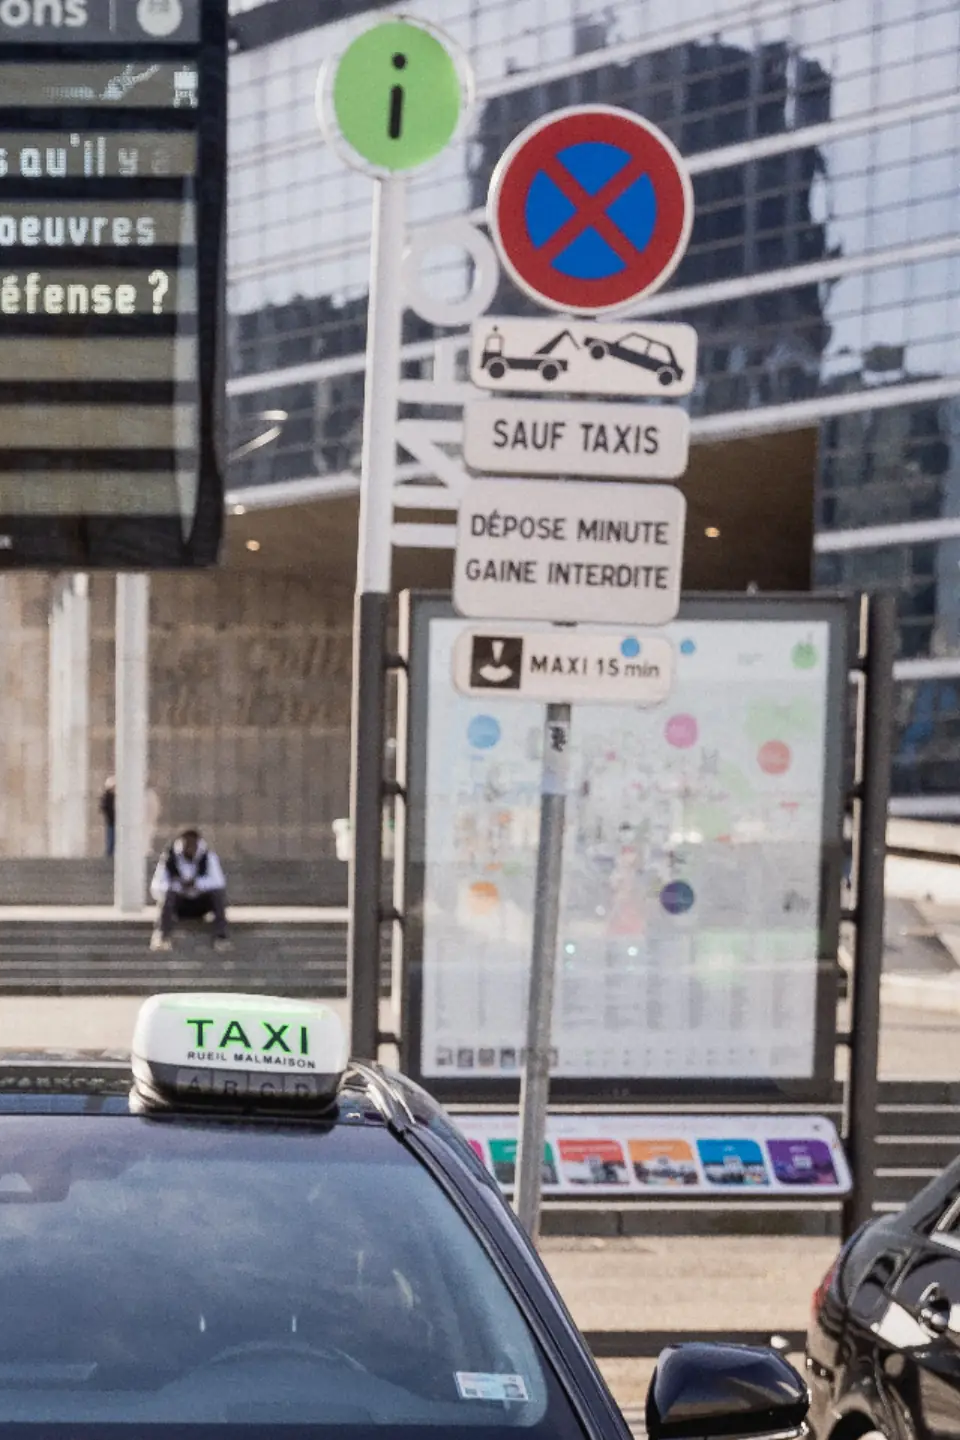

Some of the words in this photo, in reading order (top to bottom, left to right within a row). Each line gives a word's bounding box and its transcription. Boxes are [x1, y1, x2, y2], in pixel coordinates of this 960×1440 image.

[118, 147, 139, 177] y
[492, 419, 567, 450] SAUF
[580, 422, 660, 454] TAXIS
[470, 509, 567, 541] DÉPOSE
[576, 517, 670, 546] MINUTE
[465, 558, 537, 584] GAINE
[547, 561, 669, 590] INTERDITE
[530, 655, 588, 675] MAXI
[597, 657, 619, 677] 15
[623, 661, 661, 679] min
[186, 1018, 310, 1056] TAXI
[186, 1050, 228, 1062] RUEIL
[233, 1053, 317, 1069] MALMAISON
